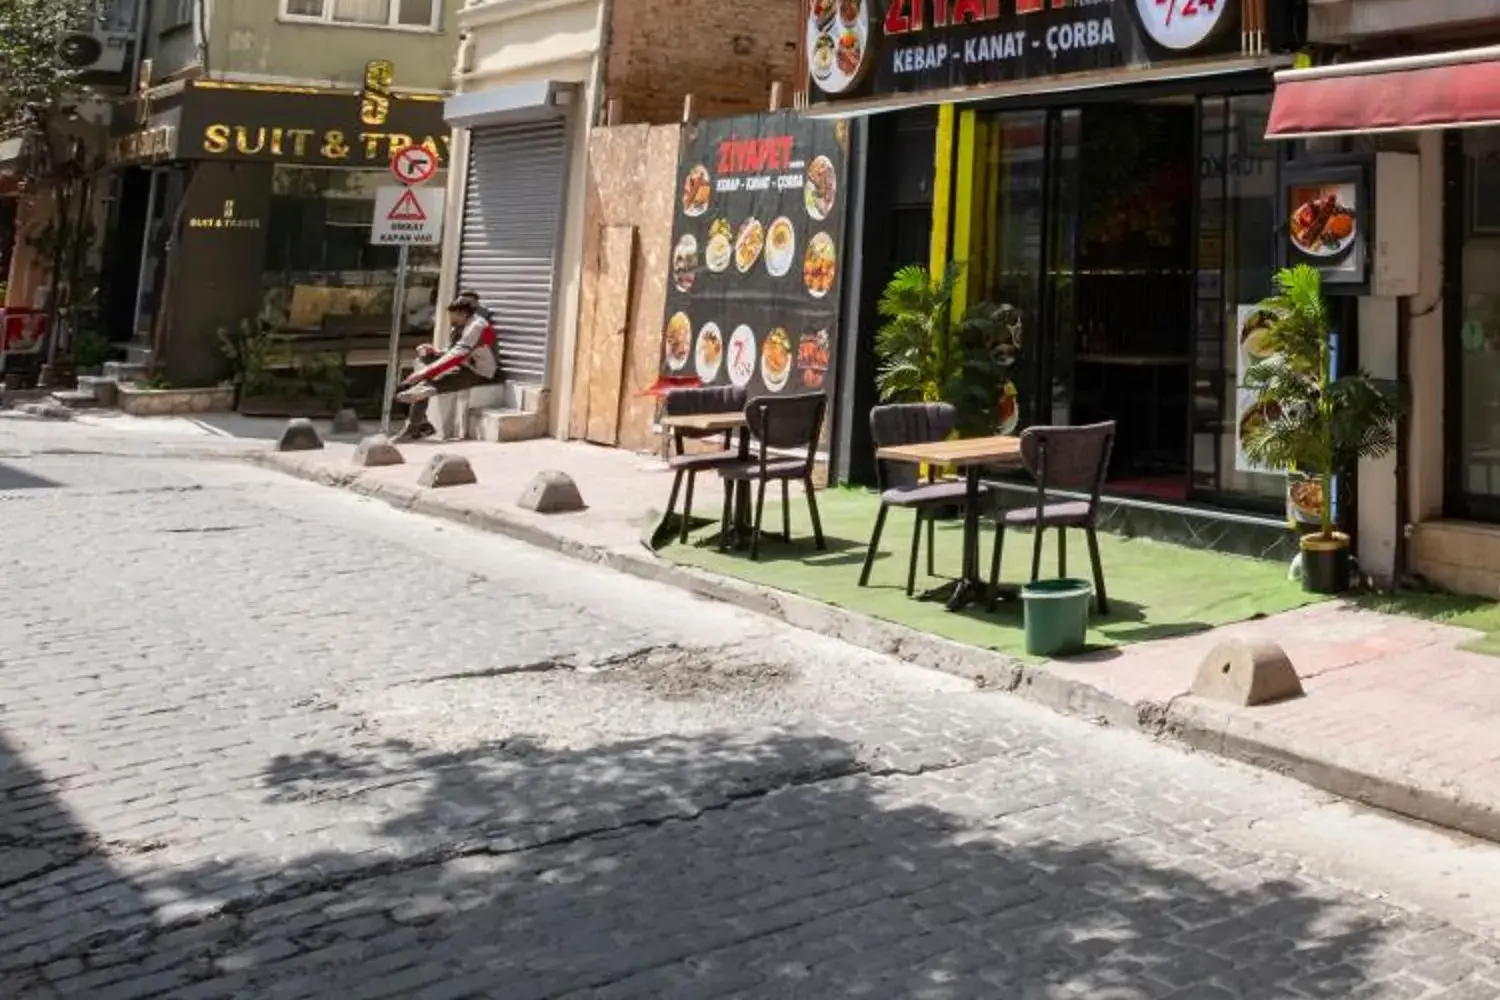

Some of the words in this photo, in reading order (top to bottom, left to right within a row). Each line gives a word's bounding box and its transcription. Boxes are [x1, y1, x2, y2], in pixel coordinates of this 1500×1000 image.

[893, 43, 948, 73] KEBAP
[964, 31, 1026, 64] KANAT
[1045, 17, 1116, 59] ÇORBA
[203, 124, 314, 156] SUIT
[319, 130, 350, 159] &
